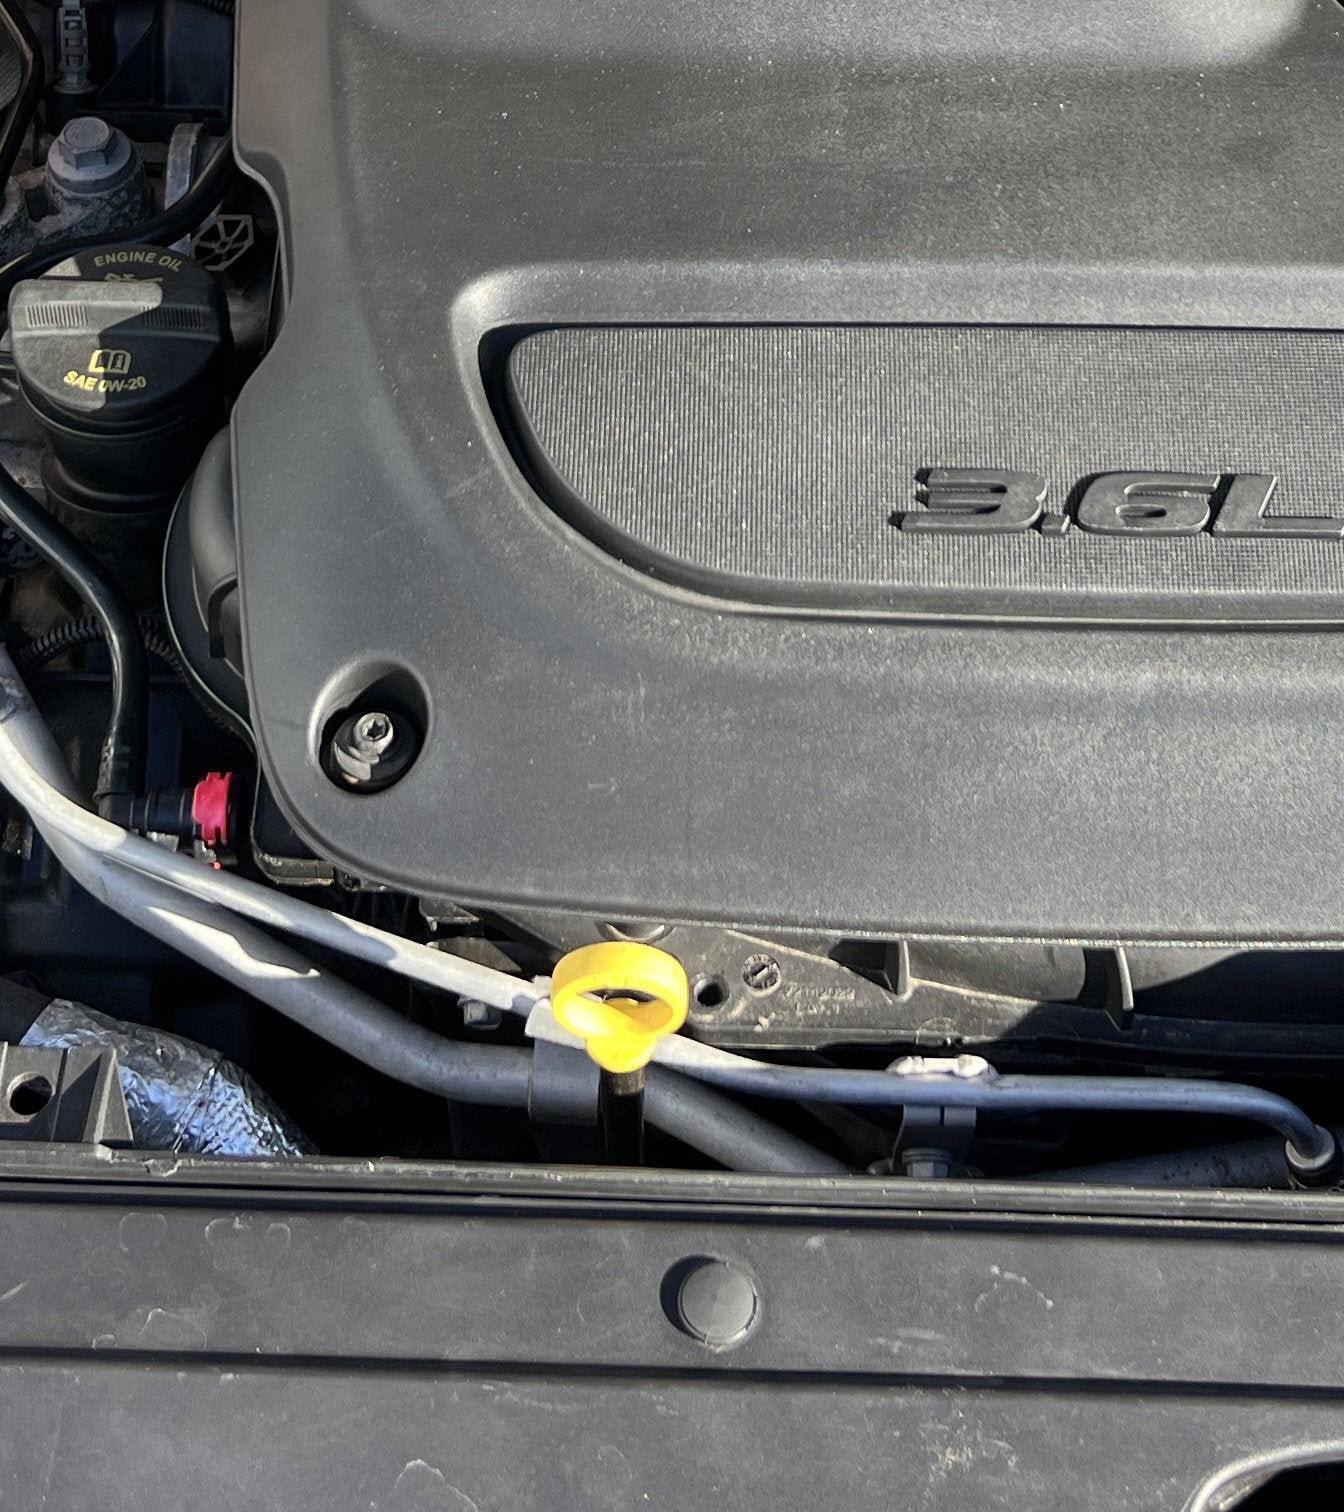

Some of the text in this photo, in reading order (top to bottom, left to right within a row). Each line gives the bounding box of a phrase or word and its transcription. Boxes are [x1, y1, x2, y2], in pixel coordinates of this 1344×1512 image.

[93, 251, 183, 272] ENGINE OIL
[63, 369, 147, 393] SAE 0W-20
